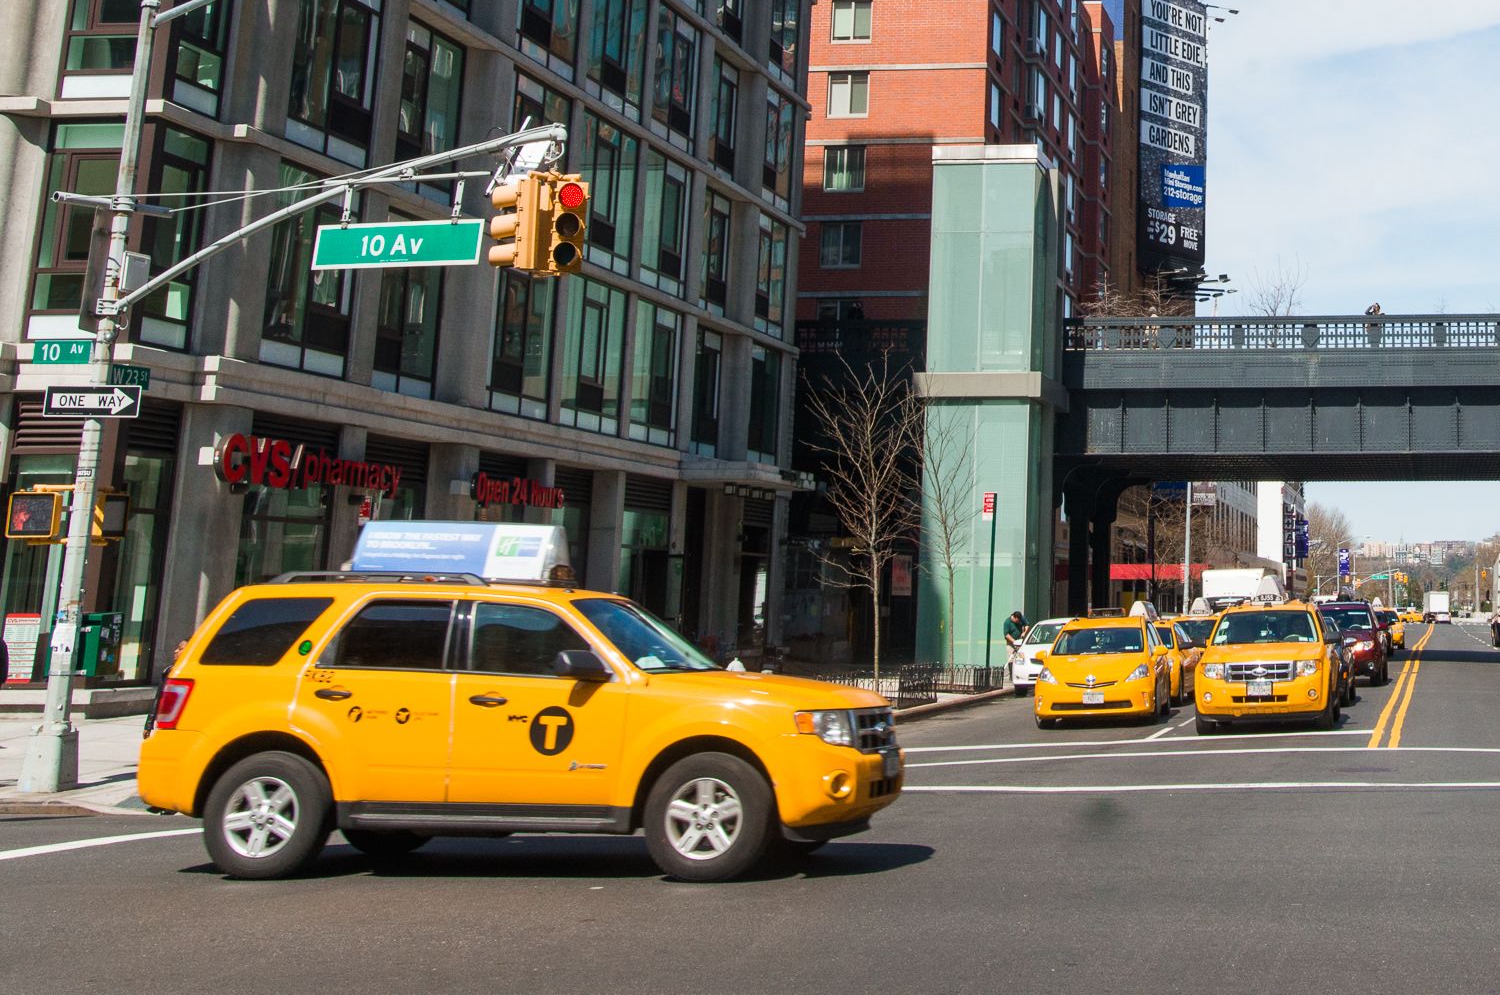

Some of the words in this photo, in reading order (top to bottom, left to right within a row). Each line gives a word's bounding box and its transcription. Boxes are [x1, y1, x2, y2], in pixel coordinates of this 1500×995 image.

[1150, 0, 1182, 27] YOU'RE
[1185, 12, 1202, 34] NOT
[1150, 29, 1180, 57] LITTLE
[1182, 39, 1203, 67] EDIE,
[1150, 62, 1168, 84] AND
[1170, 68, 1190, 92] THIS
[1150, 92, 1172, 118] ISN'T
[1175, 101, 1198, 125] GREY
[1149, 125, 1192, 155] GARDENS.
[1164, 169, 1190, 182] Manhattan
[1164, 177, 1174, 186] Mini
[1174, 180, 1202, 192] Storage.com
[1164, 186, 1202, 204] 212-storage
[1148, 208, 1176, 224] STORAGE
[1155, 222, 1176, 244] $29
[1180, 226, 1198, 240] FREE
[361, 234, 386, 256] 10
[390, 234, 424, 255] Av
[1184, 240, 1198, 250] MOVE
[42, 344, 60, 361] 10
[70, 344, 84, 354] Av
[114, 368, 124, 384] W
[126, 369, 138, 386] 23
[140, 370, 148, 381] St
[60, 395, 85, 406] ONE
[98, 395, 125, 406] WAY
[477, 472, 509, 508] Open
[512, 476, 527, 508] 24
[531, 478, 564, 508] Hours
[508, 715, 528, 723] NYC
[539, 715, 568, 750] T
